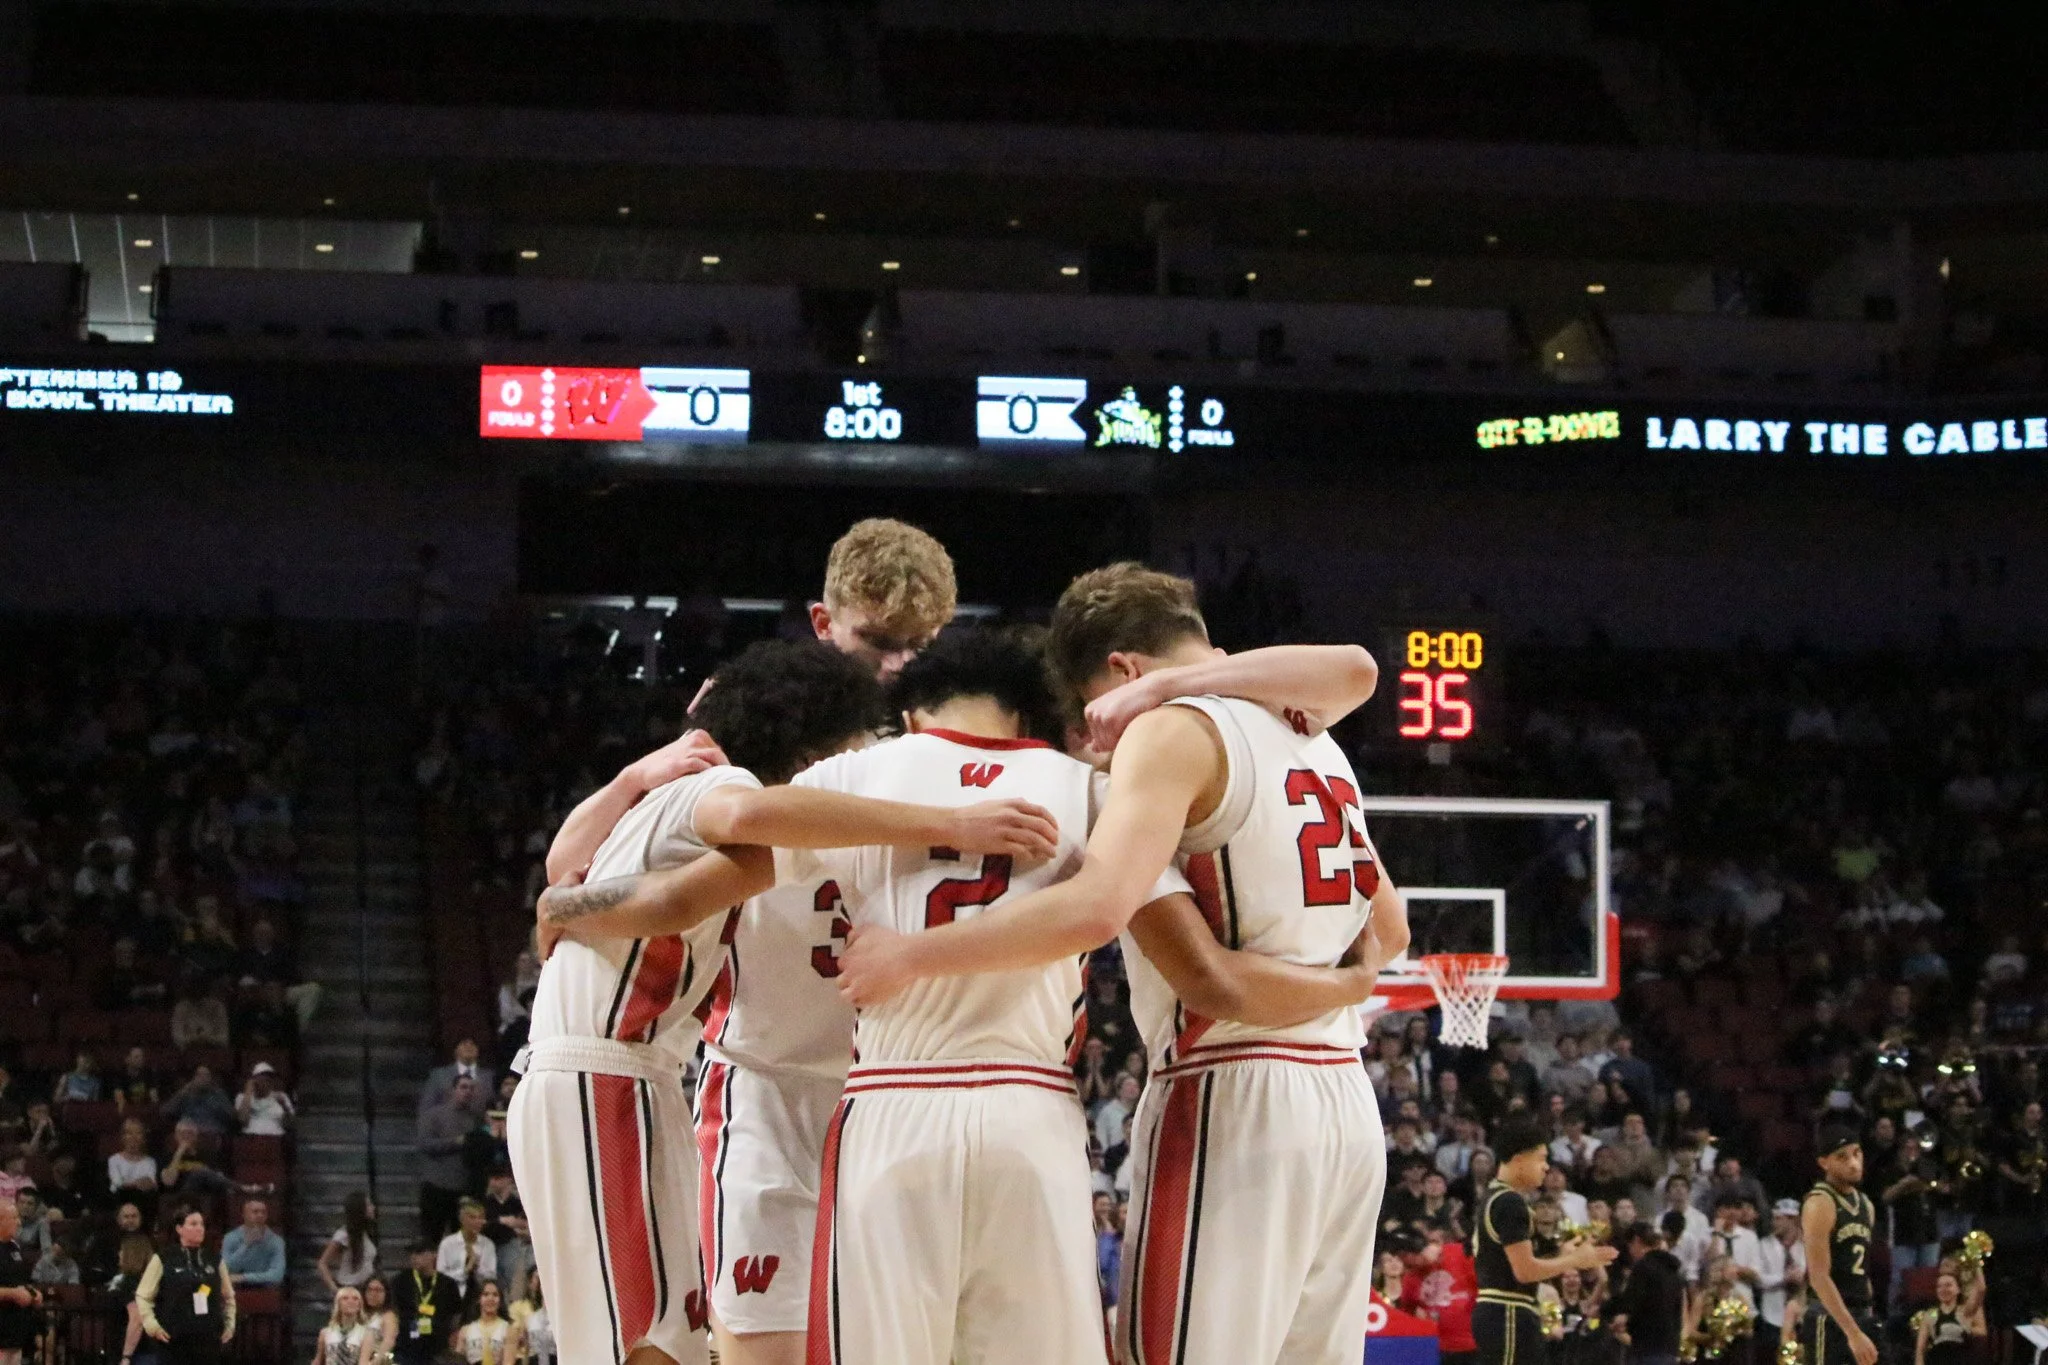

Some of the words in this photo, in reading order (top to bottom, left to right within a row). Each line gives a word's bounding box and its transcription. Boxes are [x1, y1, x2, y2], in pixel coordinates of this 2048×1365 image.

[7, 389, 96, 409] BOWL
[98, 391, 234, 413] THEATER
[501, 380, 523, 407] 0
[689, 386, 719, 426] 0
[842, 381, 882, 406] 1st
[824, 407, 901, 438] 8:00
[1008, 394, 1037, 434] 0
[1202, 399, 1223, 426] 0
[1647, 417, 1790, 453] LARRY
[1804, 422, 1888, 455] THE
[1903, 417, 2048, 455] CABLE
[1407, 631, 1482, 669] 8:00
[1399, 672, 1473, 737] 35
[960, 762, 1005, 788] W
[1285, 768, 1380, 907] 25
[733, 1254, 780, 1296] W
[1852, 1243, 1866, 1276] 2
